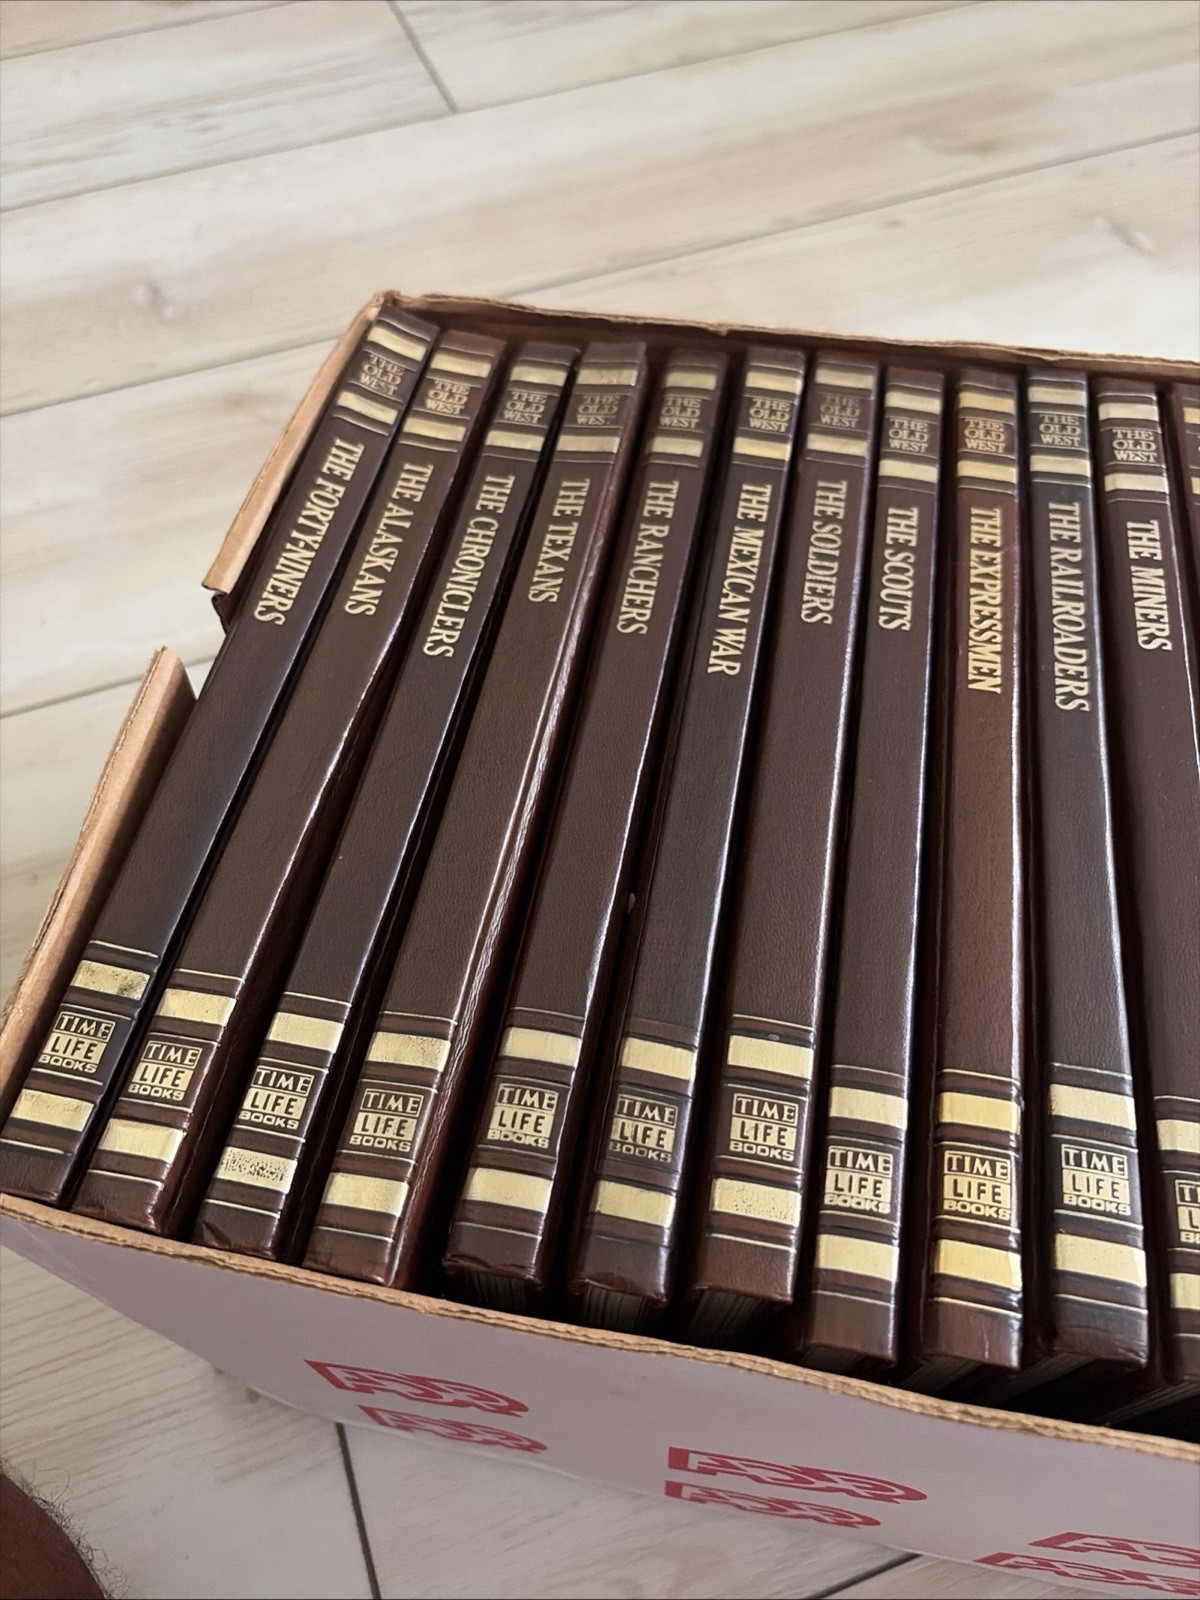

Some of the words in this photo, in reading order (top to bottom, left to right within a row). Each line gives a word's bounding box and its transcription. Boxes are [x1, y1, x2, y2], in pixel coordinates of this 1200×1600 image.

[363, 364, 401, 386] OLD
[368, 354, 404, 376] THE
[360, 373, 399, 396] WEST
[434, 379, 471, 396] THE
[425, 398, 462, 415] WEST
[428, 388, 467, 405] OLD
[506, 401, 544, 414] OLD
[511, 392, 548, 403] THE
[667, 397, 701, 410] THE
[752, 397, 791, 412] THE
[503, 411, 542, 424] WEST
[578, 403, 617, 415] OLD
[661, 405, 700, 419] OLD
[749, 406, 790, 421] OLD
[820, 402, 860, 417] OLD
[1039, 413, 1079, 426] THE
[660, 416, 700, 428] WEST
[749, 417, 789, 433] WEST
[820, 414, 860, 428] WEST
[890, 418, 928, 433] THE
[964, 417, 1004, 431] THE
[1039, 423, 1080, 437] OLD
[888, 427, 928, 443] OLD
[888, 438, 928, 452] WEST
[964, 428, 1005, 443] OLD
[965, 439, 1005, 453] WEST
[1041, 434, 1080, 447] WEST
[1112, 429, 1154, 440] THE
[1112, 439, 1156, 452] OLD
[320, 438, 365, 481] THE
[1113, 450, 1157, 463] WEST
[391, 462, 434, 502] THE
[475, 475, 515, 513] THE
[552, 478, 591, 518] THE
[643, 480, 679, 519] THE
[736, 483, 773, 522] THE
[812, 480, 848, 519] THE
[885, 507, 919, 547] THE
[970, 506, 1001, 547] THE
[1049, 502, 1082, 543] THE
[253, 478, 345, 626] FORTY-NINERS
[1126, 520, 1162, 561] THE
[344, 503, 414, 616] ALASKANS
[528, 522, 579, 603] TEXANS
[616, 524, 670, 635] RANCHERS
[718, 526, 765, 623] MEXICAN
[801, 520, 842, 625] SOLDIERS
[423, 516, 499, 659] CHRONICLERS
[878, 548, 914, 631] SCOUTS
[1131, 567, 1172, 651] MINERS
[967, 549, 1003, 694] EXPRESSMEN
[1050, 549, 1090, 712] RAILROADERS
[707, 627, 746, 676] WAR
[57, 1016, 112, 1039] TIME
[50, 1035, 98, 1060] LIFE
[146, 1044, 199, 1066] TIME
[38, 1054, 98, 1074] BOOKS
[138, 1064, 185, 1087] LIFE
[127, 1083, 185, 1101] BOOKS
[254, 1069, 312, 1093] TIME
[250, 1091, 298, 1116] LIFE
[363, 1092, 421, 1114] TIME
[500, 1086, 557, 1110] TIME
[736, 1097, 796, 1122] TIME
[238, 1110, 299, 1130] BOOKS
[497, 1109, 545, 1134] LIFE
[618, 1099, 675, 1124] TIME
[361, 1114, 408, 1138] LIFE
[619, 1121, 666, 1148] LIFE
[739, 1121, 788, 1144] LIFE
[349, 1136, 411, 1151] BOOKS
[486, 1129, 549, 1149] BOOKS
[608, 1141, 672, 1163] BOOKS
[729, 1141, 794, 1161] BOOKS
[830, 1150, 892, 1174] TIME
[948, 1154, 1009, 1178] TIME
[1064, 1149, 1125, 1177] TIME
[833, 1174, 883, 1198] LIFE
[952, 1177, 1002, 1201] LIFE
[1071, 1172, 1120, 1199] LIFE
[824, 1194, 891, 1215] BOOKS
[943, 1200, 1012, 1221] BOOKS
[1063, 1193, 1131, 1216] BOOKS
